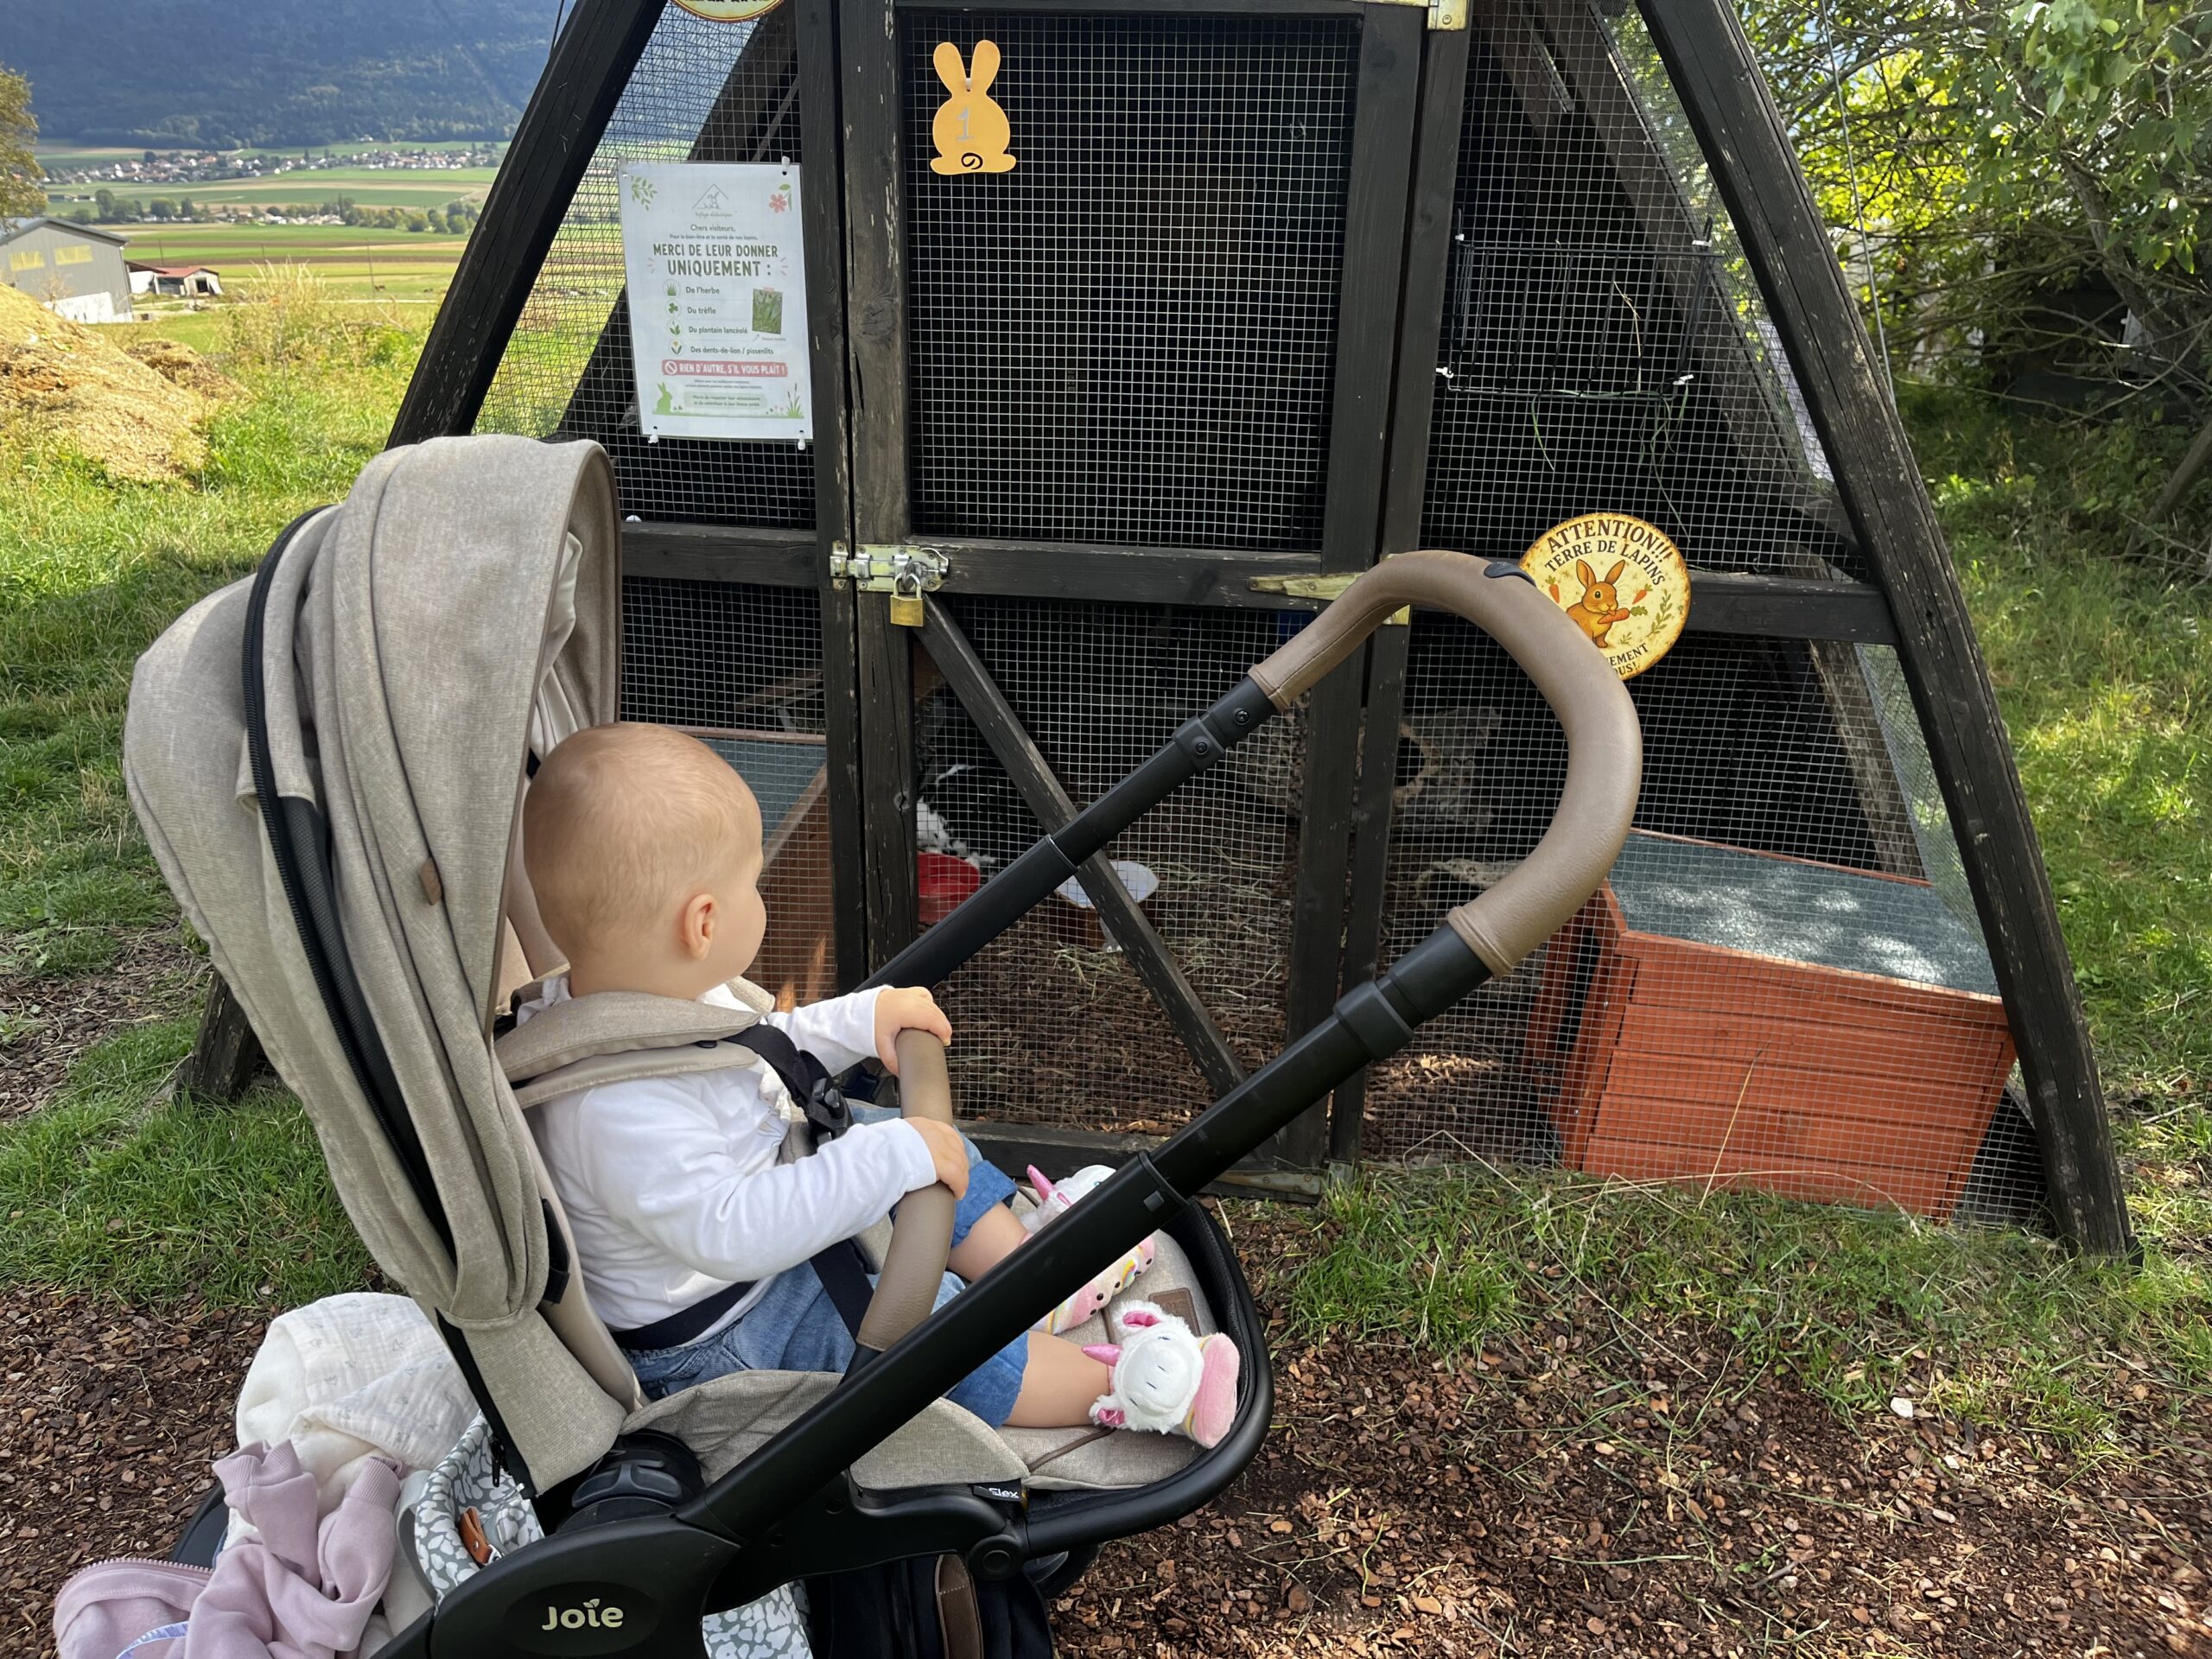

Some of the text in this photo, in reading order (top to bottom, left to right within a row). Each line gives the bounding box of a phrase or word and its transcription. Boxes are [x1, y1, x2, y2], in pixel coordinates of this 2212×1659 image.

[957, 106, 975, 143] 1
[653, 244, 779, 257] MERCI DE LEUR DONNER
[667, 259, 761, 276] UNIQUEMENT
[696, 286, 720, 295] l'herbe
[679, 363, 695, 373] RIEN
[696, 363, 727, 374] D'AUTRE,
[728, 364, 741, 374] S'IL
[741, 365, 760, 374] VOUS
[1546, 519, 1674, 563] ATTENTION!!!
[1544, 540, 1666, 586] TERRE DE LAPINS
[542, 1598, 624, 1630] Joie
